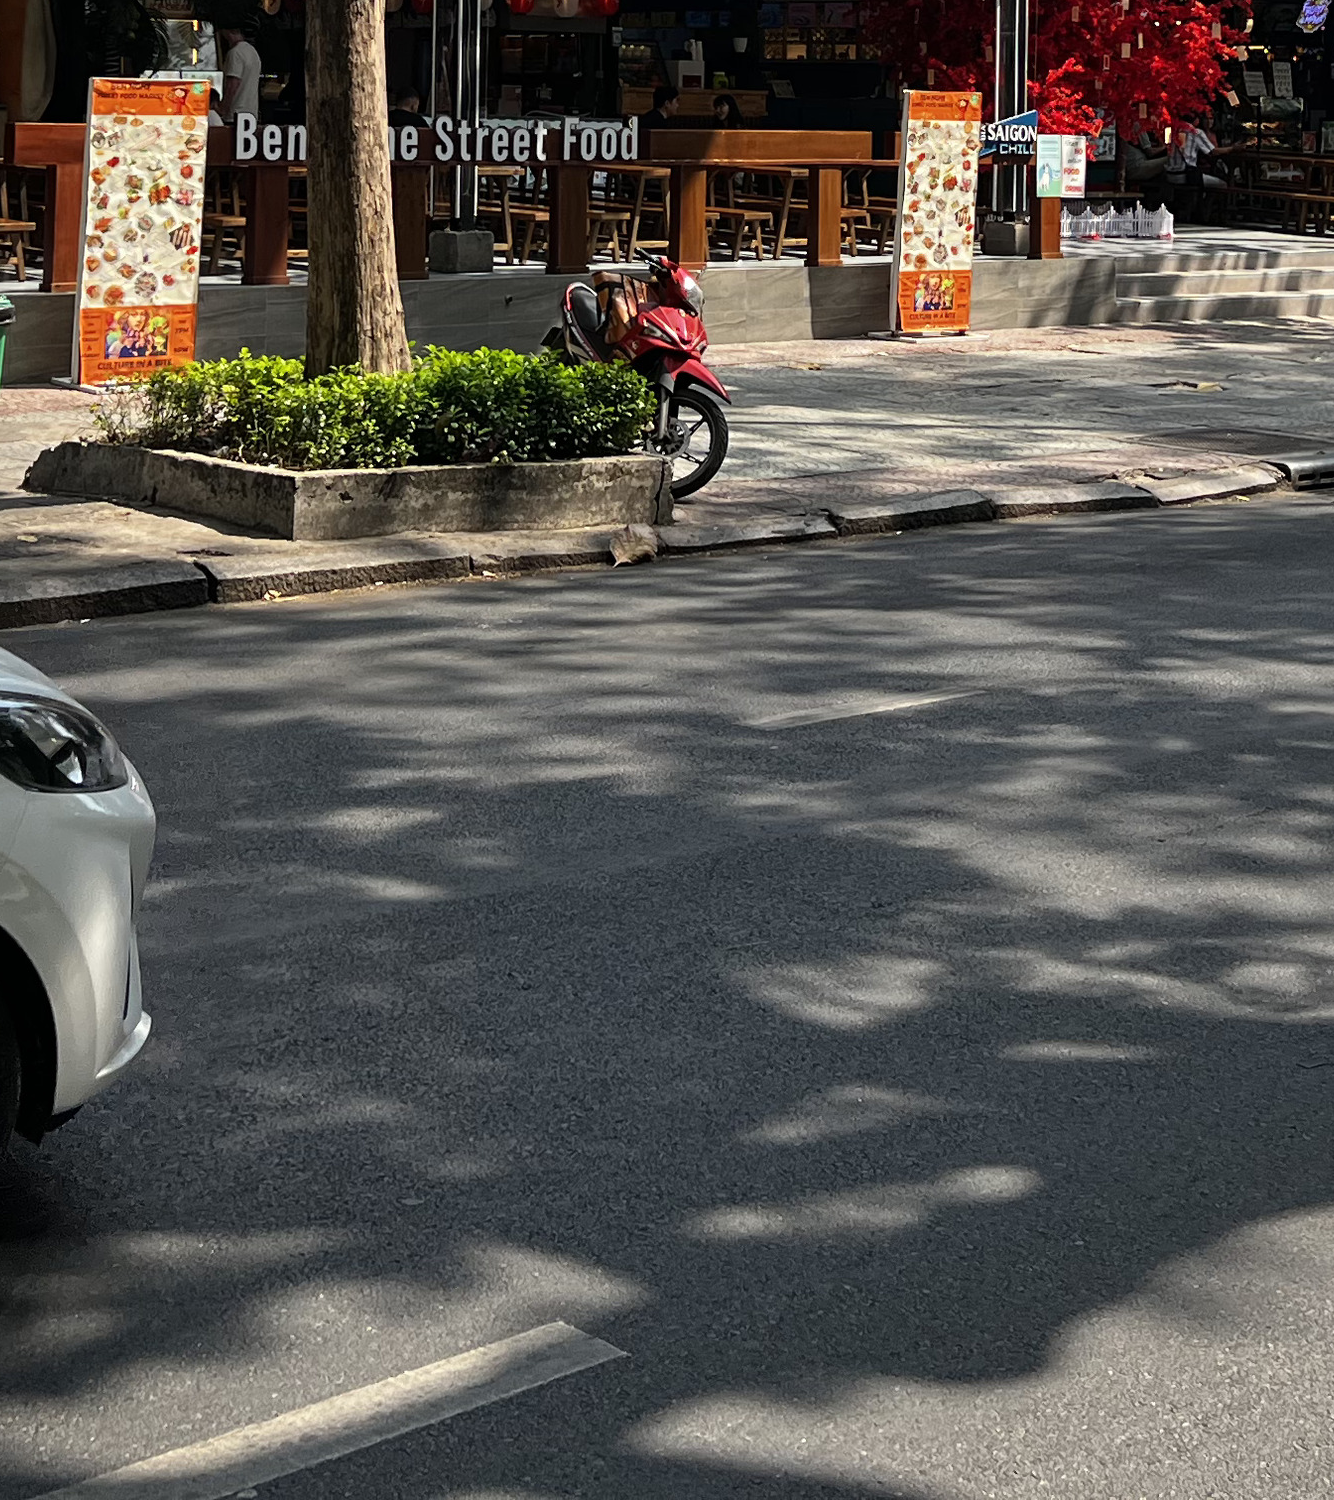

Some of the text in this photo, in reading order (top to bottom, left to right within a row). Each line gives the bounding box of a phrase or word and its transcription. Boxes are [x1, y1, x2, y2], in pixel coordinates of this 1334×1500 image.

[236, 113, 307, 161] Ben
[435, 115, 547, 162] Street
[564, 116, 638, 161] Food
[988, 124, 1037, 141] SAIGON
[1000, 144, 1035, 154] CHILL
[97, 361, 134, 370] CULTURE
